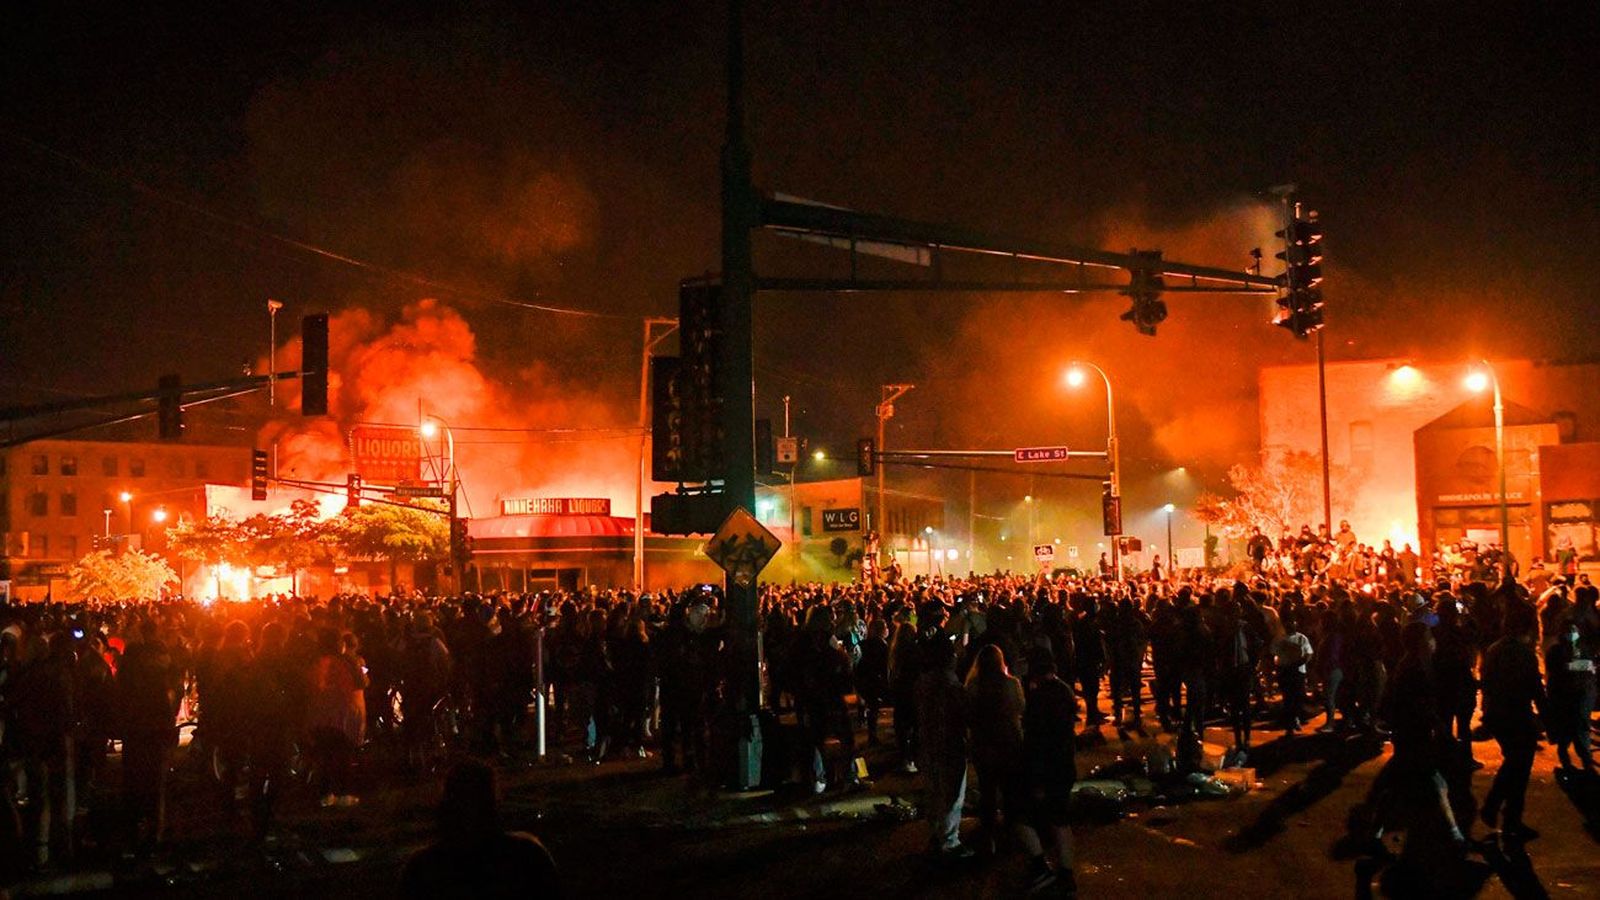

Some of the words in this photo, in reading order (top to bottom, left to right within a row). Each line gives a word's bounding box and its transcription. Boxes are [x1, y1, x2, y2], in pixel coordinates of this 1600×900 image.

[357, 437, 419, 459] LIQUORS
[1018, 451, 1024, 459] E
[1028, 451, 1050, 459] Lake
[1054, 450, 1065, 458] St
[1494, 492, 1523, 500] PLICE
[504, 499, 562, 515] MINNEHAHA
[568, 499, 608, 514] LIQUORS
